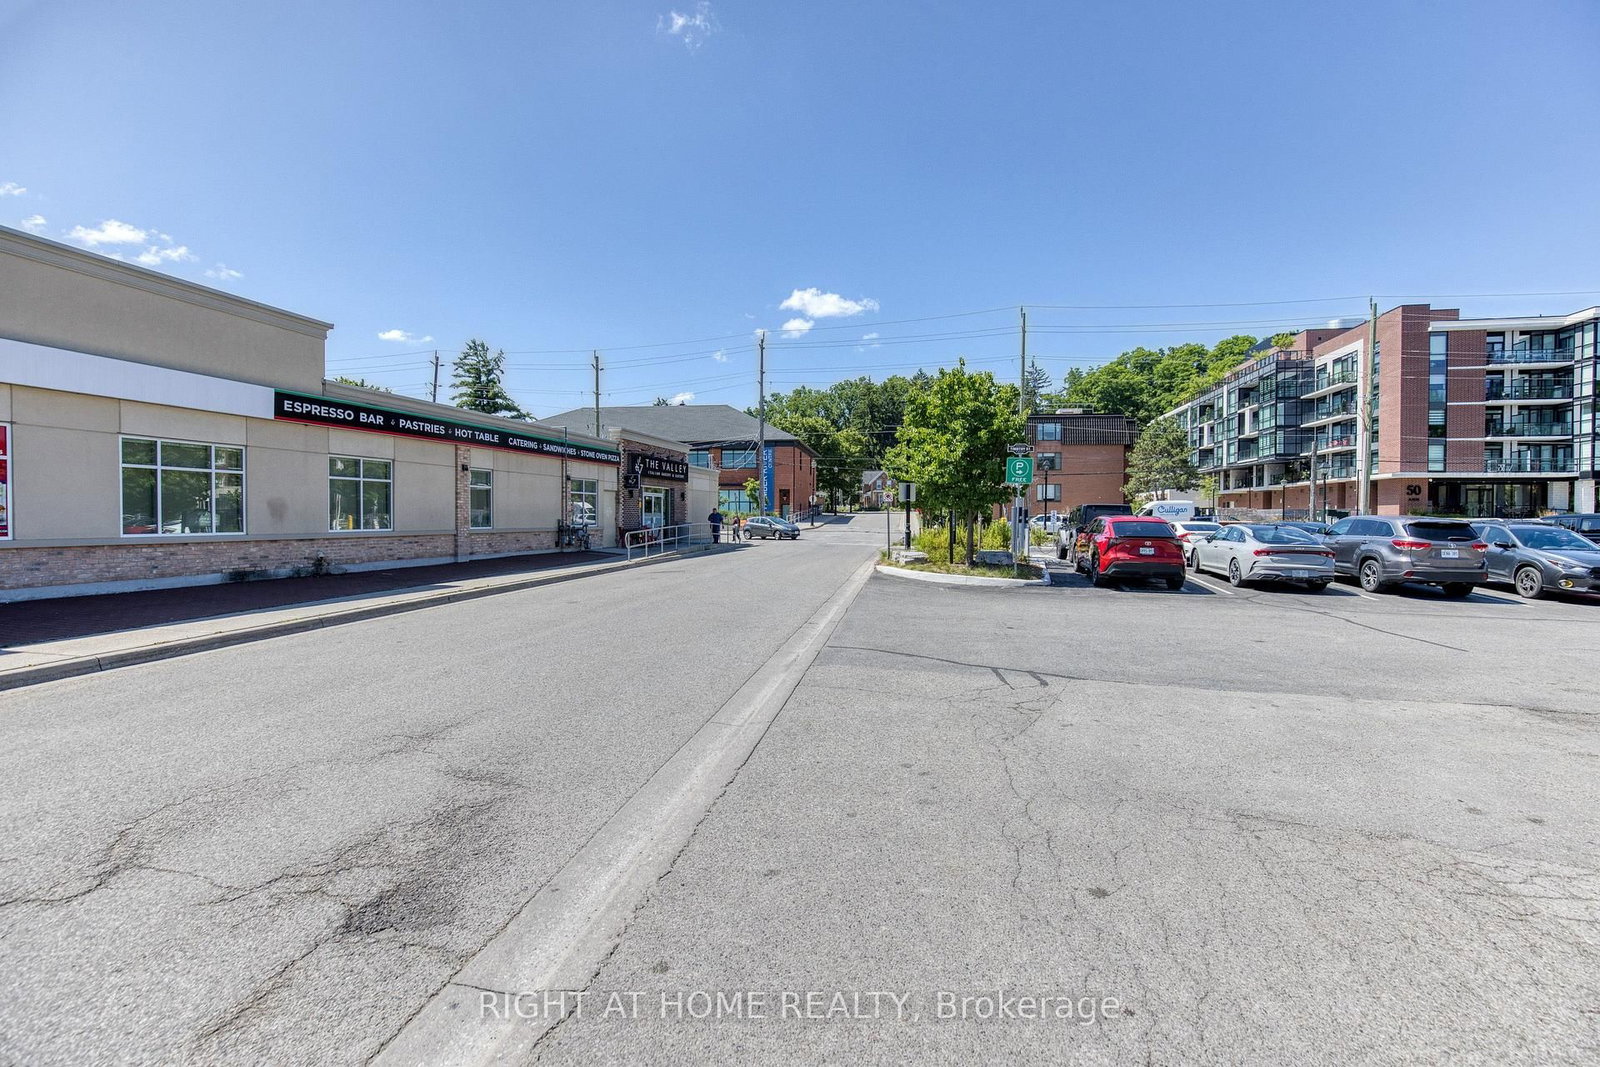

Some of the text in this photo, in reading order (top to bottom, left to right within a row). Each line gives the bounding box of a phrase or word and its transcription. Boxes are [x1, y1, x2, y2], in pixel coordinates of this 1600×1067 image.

[284, 400, 384, 425] ESPRESSO BAR
[399, 419, 446, 434] PASTRIES
[455, 428, 499, 442] HOT TABLE
[508, 437, 538, 449] CATERING
[580, 450, 595, 458] STONE
[596, 452, 608, 460] OVEN
[645, 458, 687, 473] THE VALLEY
[1016, 462, 1024, 470] P
[1406, 484, 1422, 495] 50
[1157, 505, 1188, 516] Culligan
